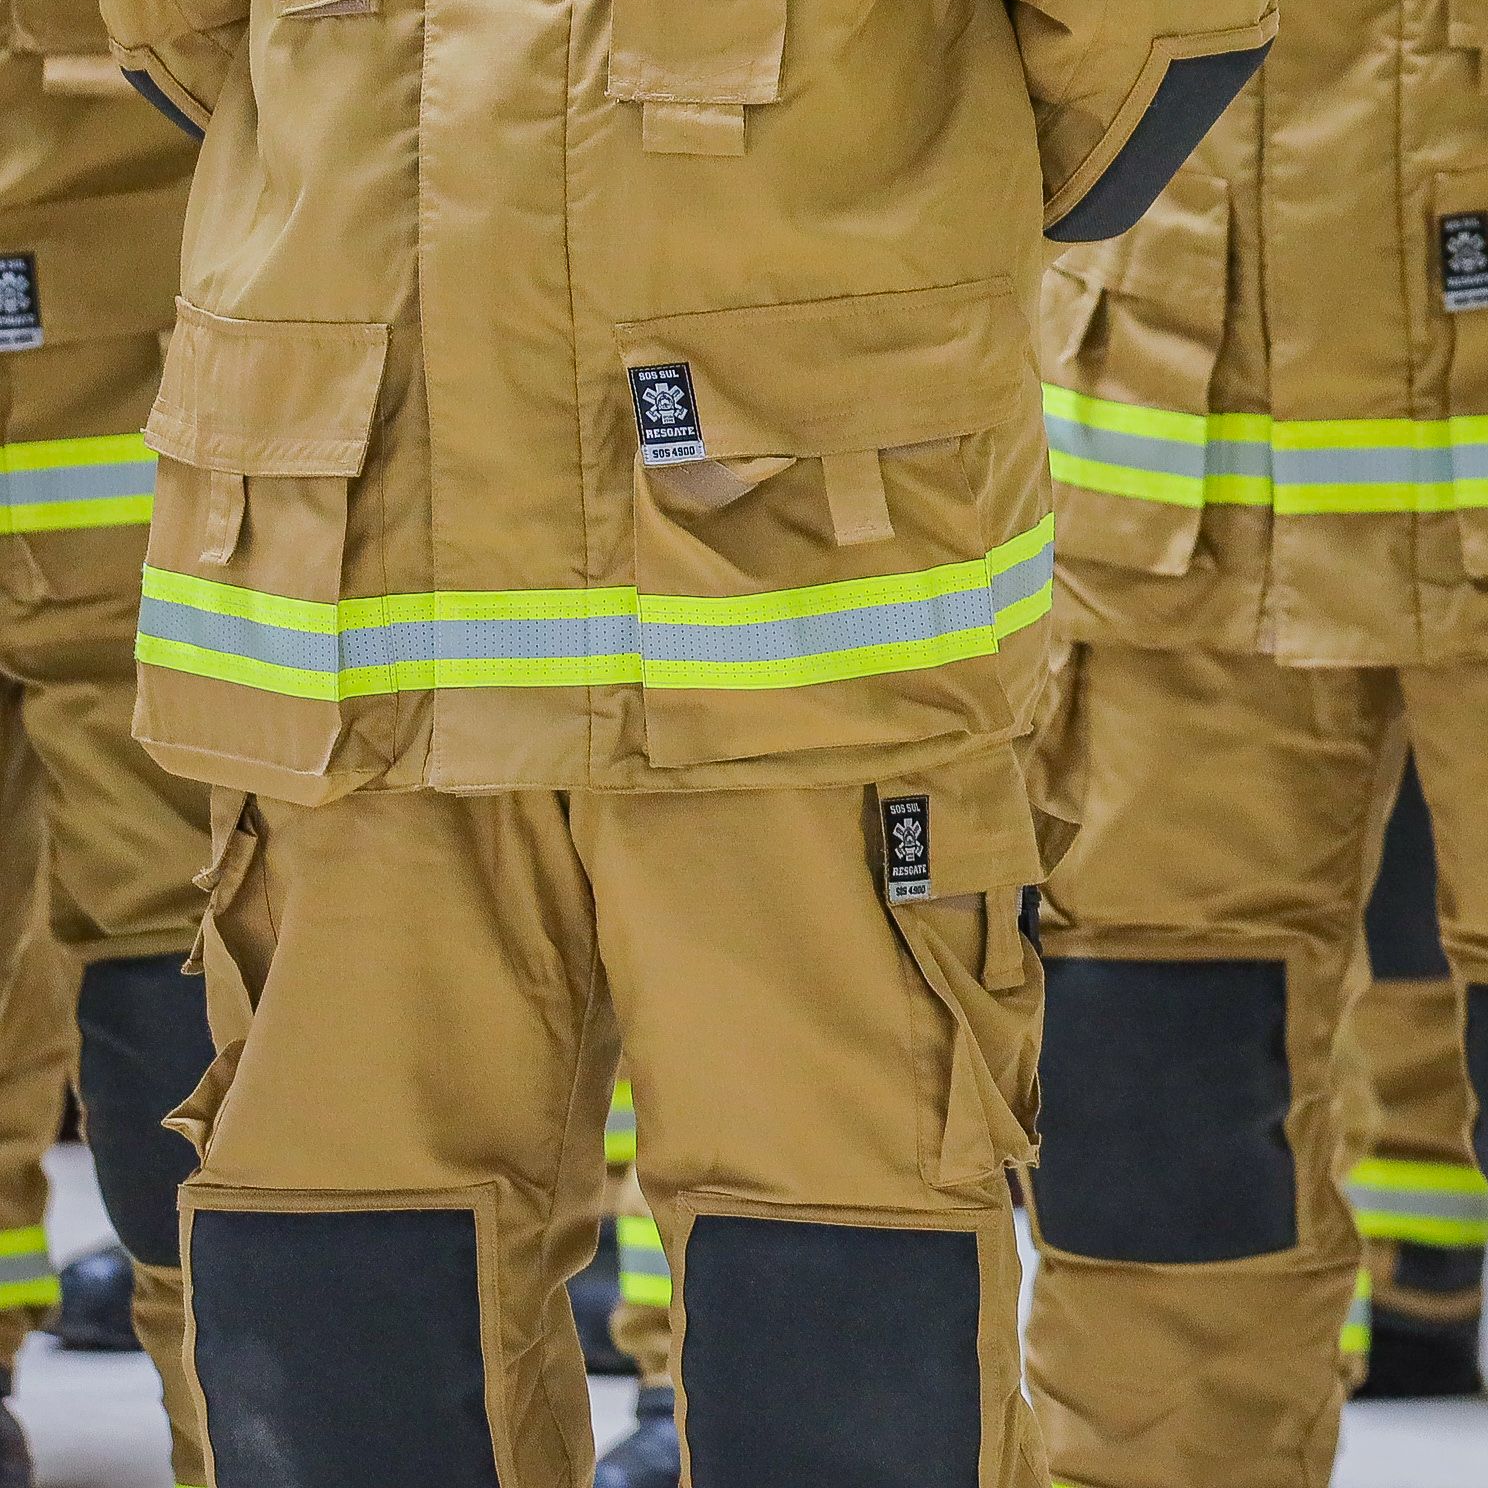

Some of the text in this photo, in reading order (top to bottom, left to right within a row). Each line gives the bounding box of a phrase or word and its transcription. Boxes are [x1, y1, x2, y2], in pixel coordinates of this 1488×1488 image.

[639, 369, 679, 381] SOS SUL
[645, 426, 695, 439] RESGATE
[652, 446, 695, 458] SOS 4900
[890, 802, 921, 815] SOS SUL
[892, 864, 927, 877] RESGATE
